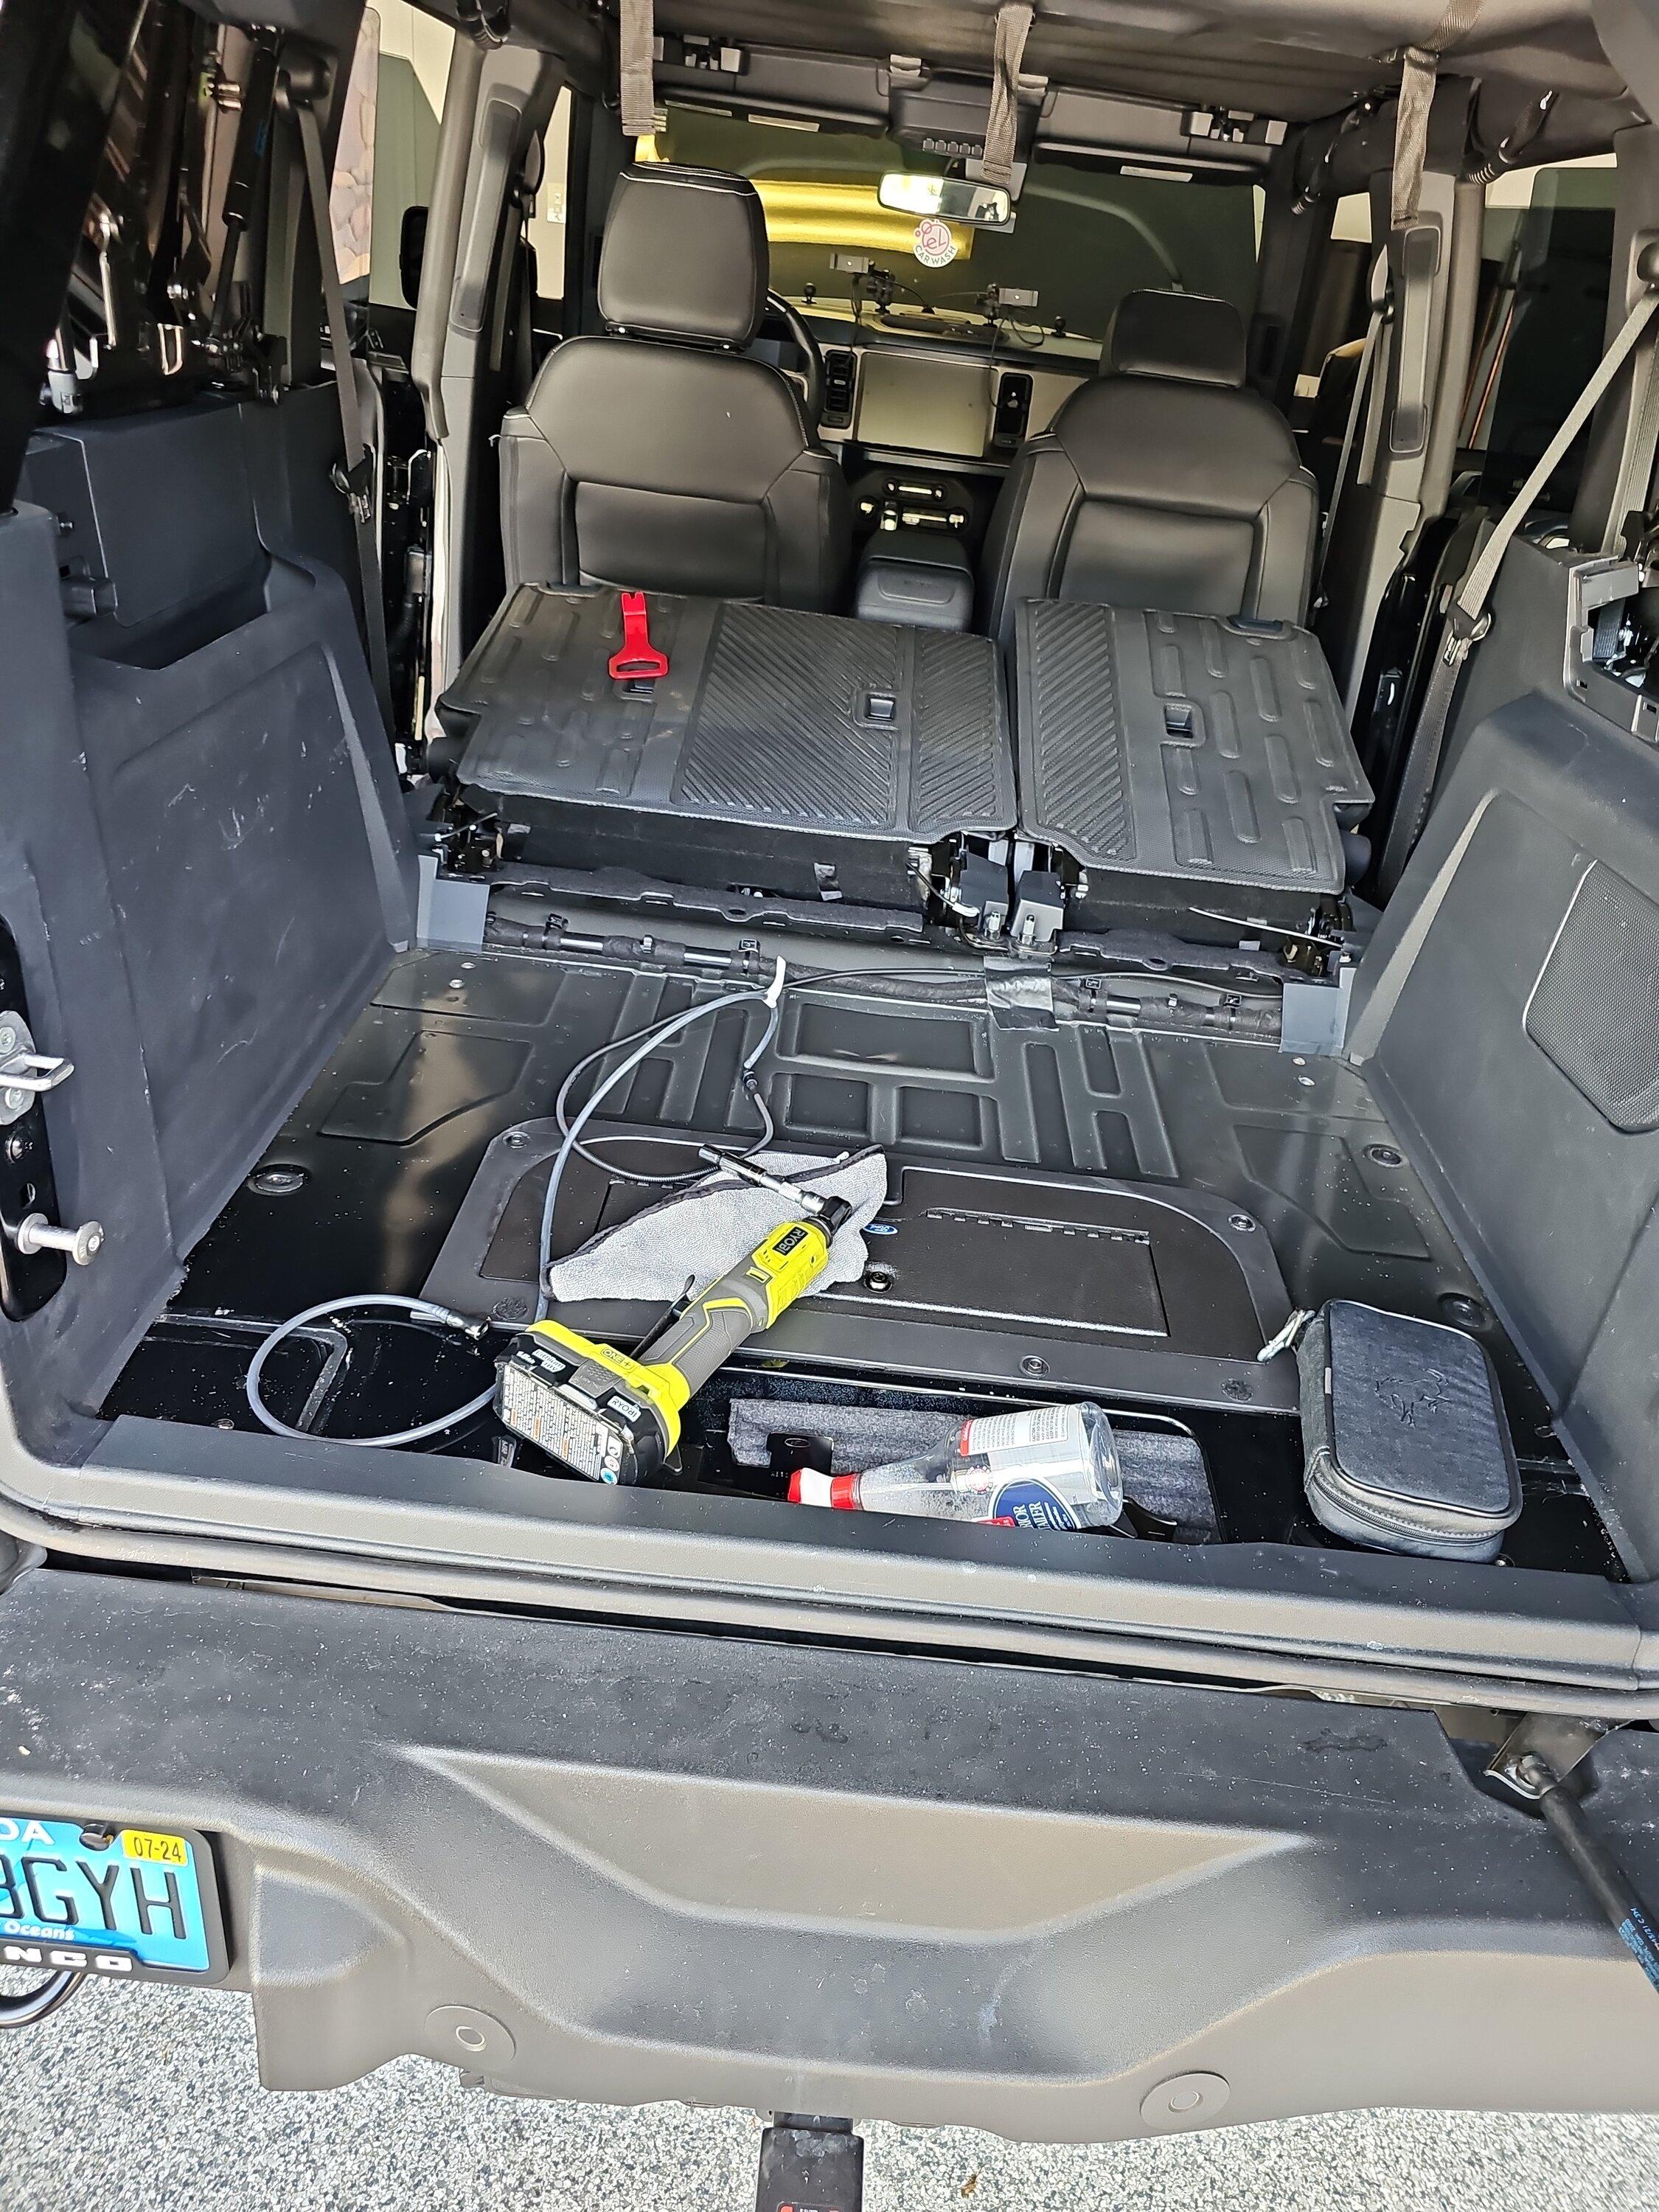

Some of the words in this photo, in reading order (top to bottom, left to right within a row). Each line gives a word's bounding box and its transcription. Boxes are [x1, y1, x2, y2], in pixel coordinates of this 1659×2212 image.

[775, 1228, 807, 1254] RYOBI
[611, 1398, 639, 1419] RYOBI
[133, 1836, 182, 1863] 07-24
[4, 1919, 76, 1941] Oceans
